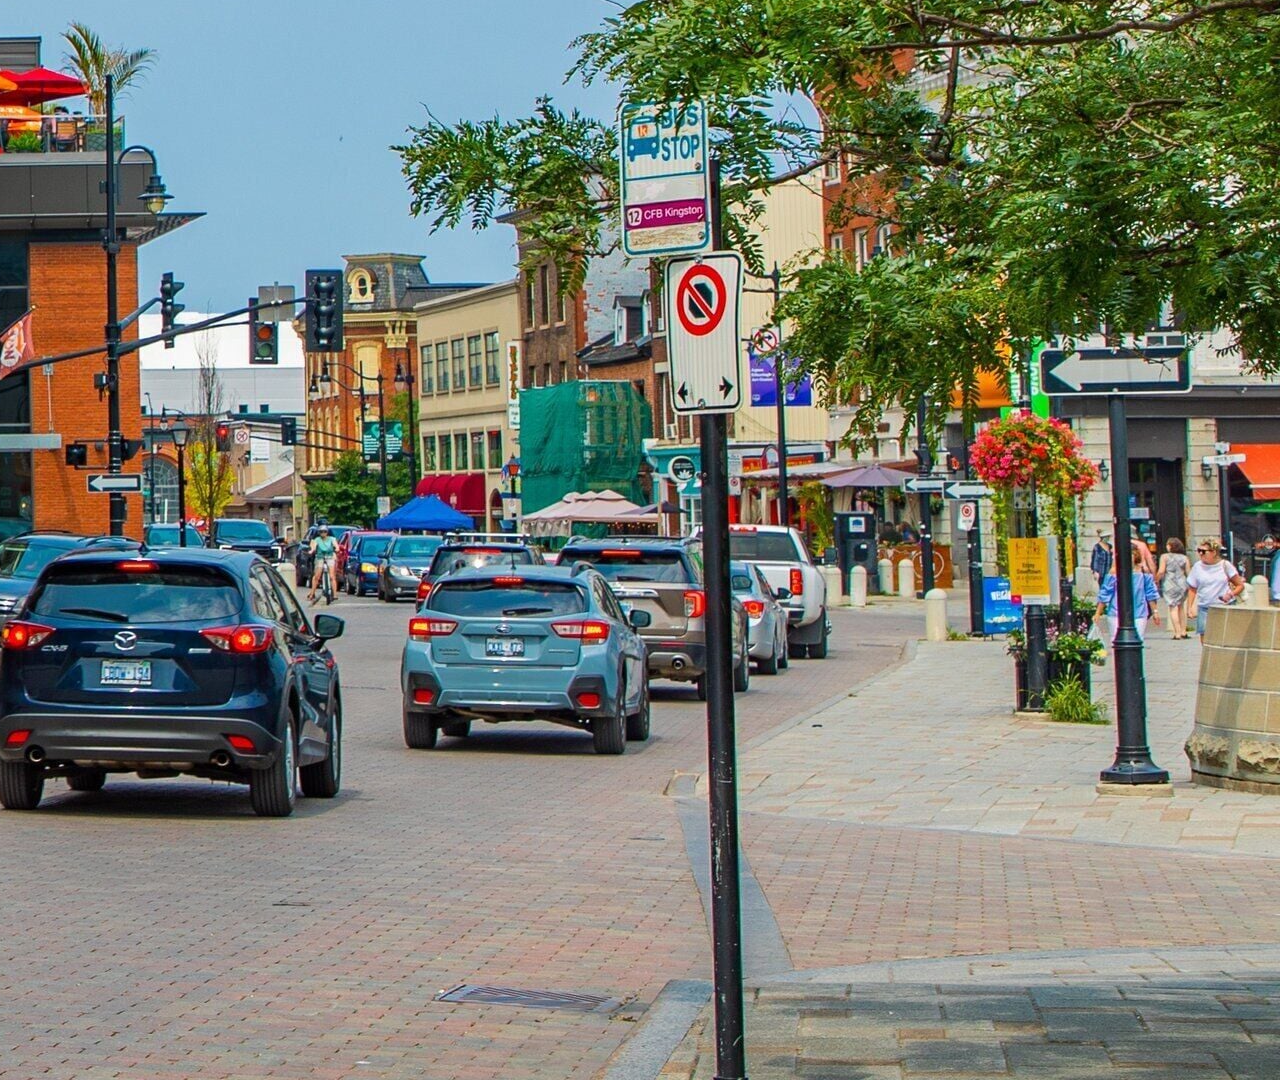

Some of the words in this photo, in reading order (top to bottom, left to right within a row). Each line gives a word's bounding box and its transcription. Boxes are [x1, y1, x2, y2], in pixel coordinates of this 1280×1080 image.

[662, 134, 700, 161] STOP
[628, 210, 641, 224] 12
[644, 209, 663, 220] CFB
[665, 205, 703, 218] Kingston
